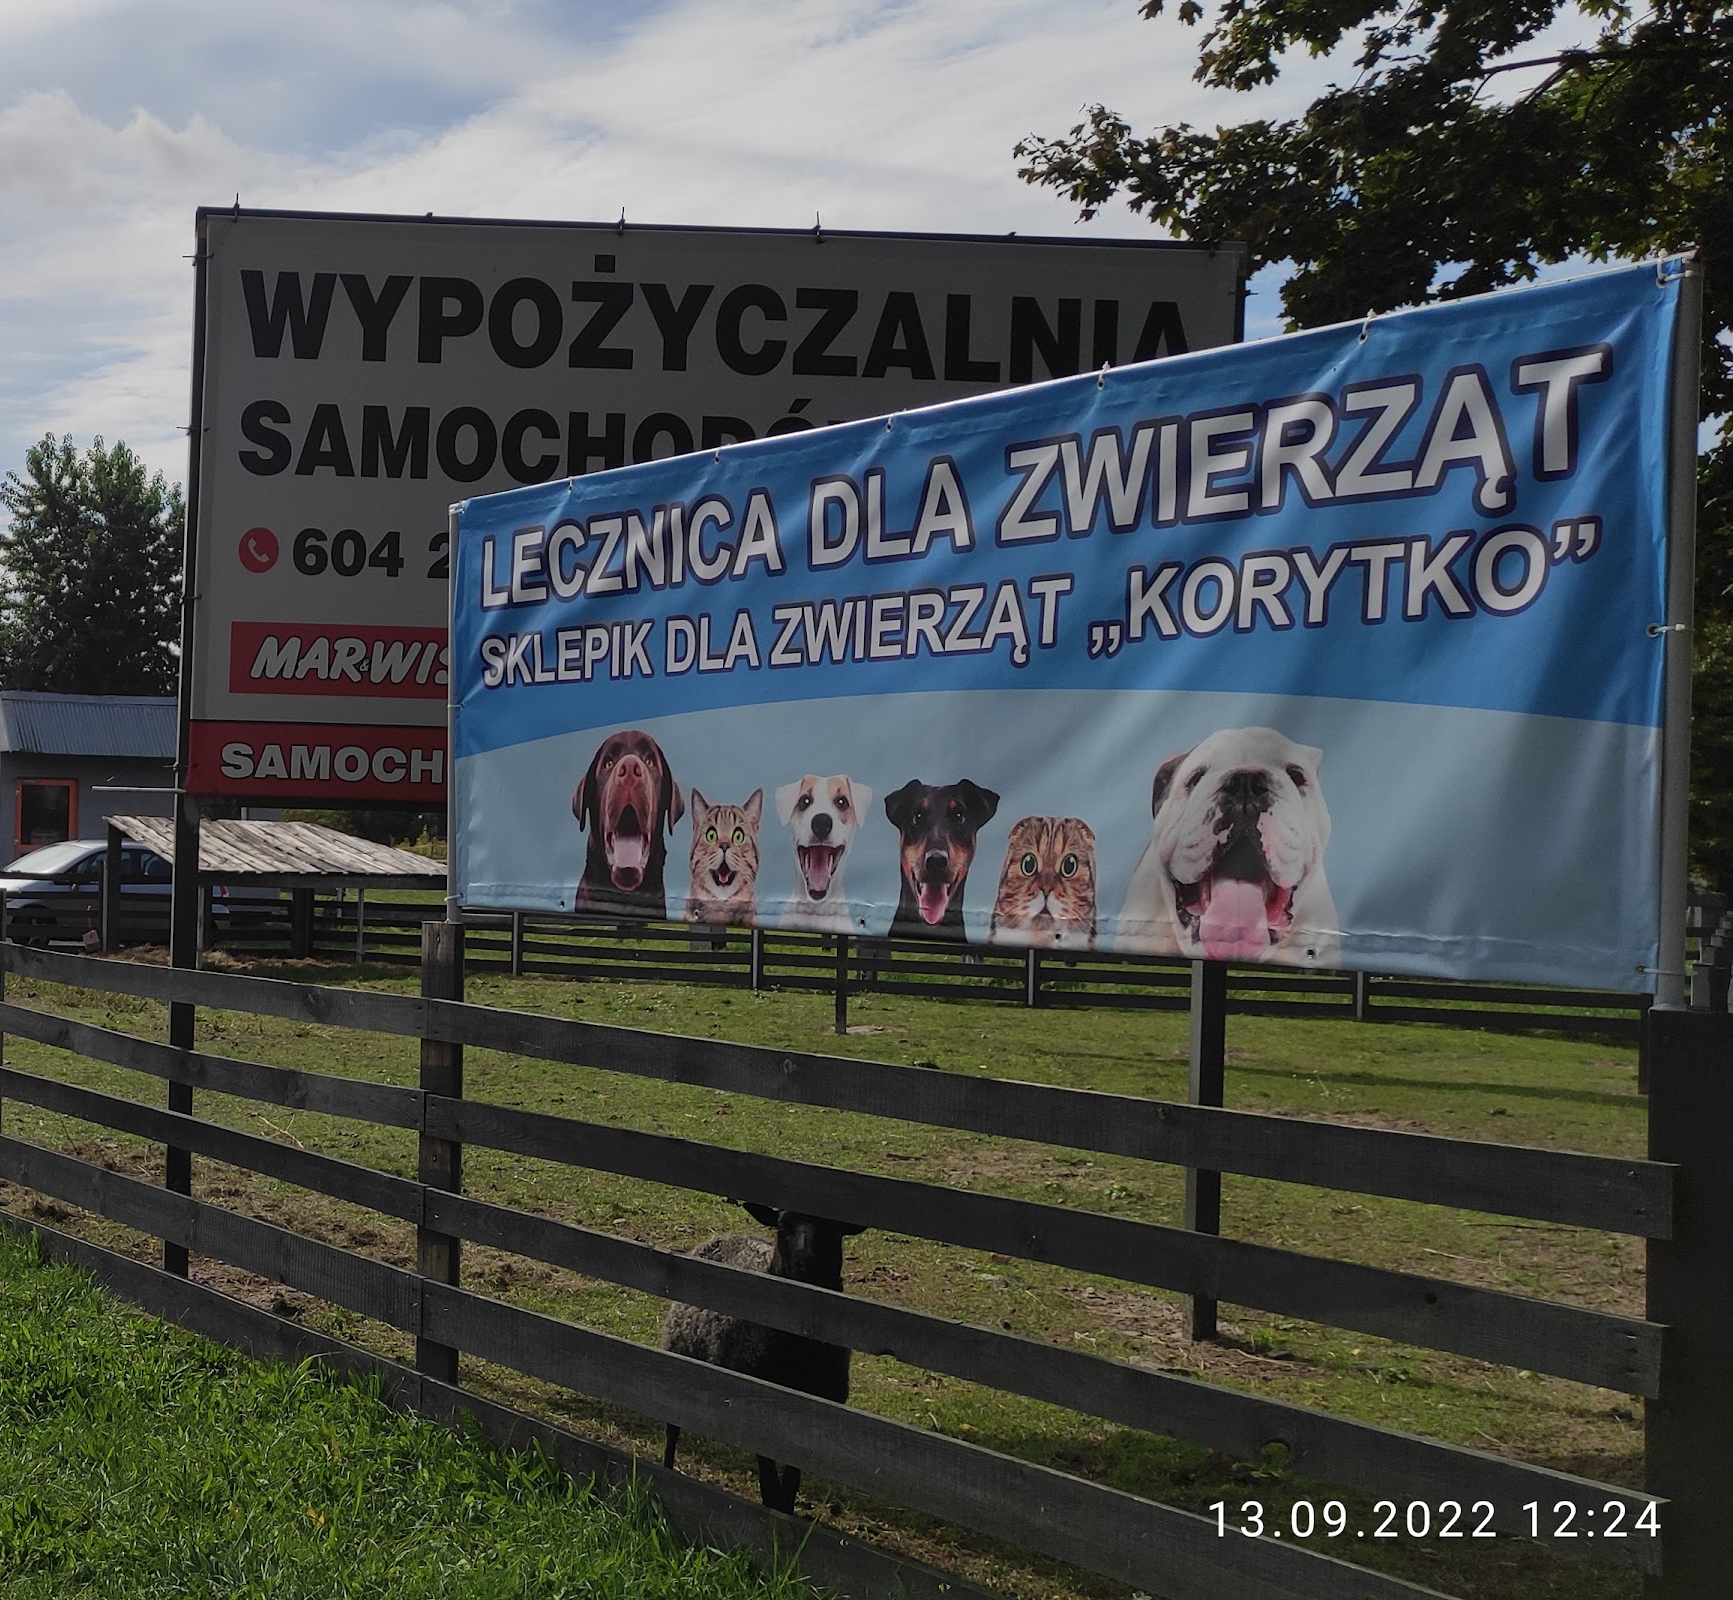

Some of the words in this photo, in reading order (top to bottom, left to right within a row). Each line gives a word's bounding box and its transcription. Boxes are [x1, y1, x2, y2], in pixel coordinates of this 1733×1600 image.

[240, 254, 1189, 383] WYPOŻYCZALNIA
[239, 398, 850, 484] SAMOCHO
[482, 494, 783, 607] LECZNICA
[811, 462, 969, 567] DLA
[999, 352, 1603, 543] ZWIERZĄT
[293, 528, 404, 577] 604
[481, 621, 652, 686] SKLEPIK
[666, 611, 760, 674] DLA
[770, 578, 1071, 665] ZWIERZĄT
